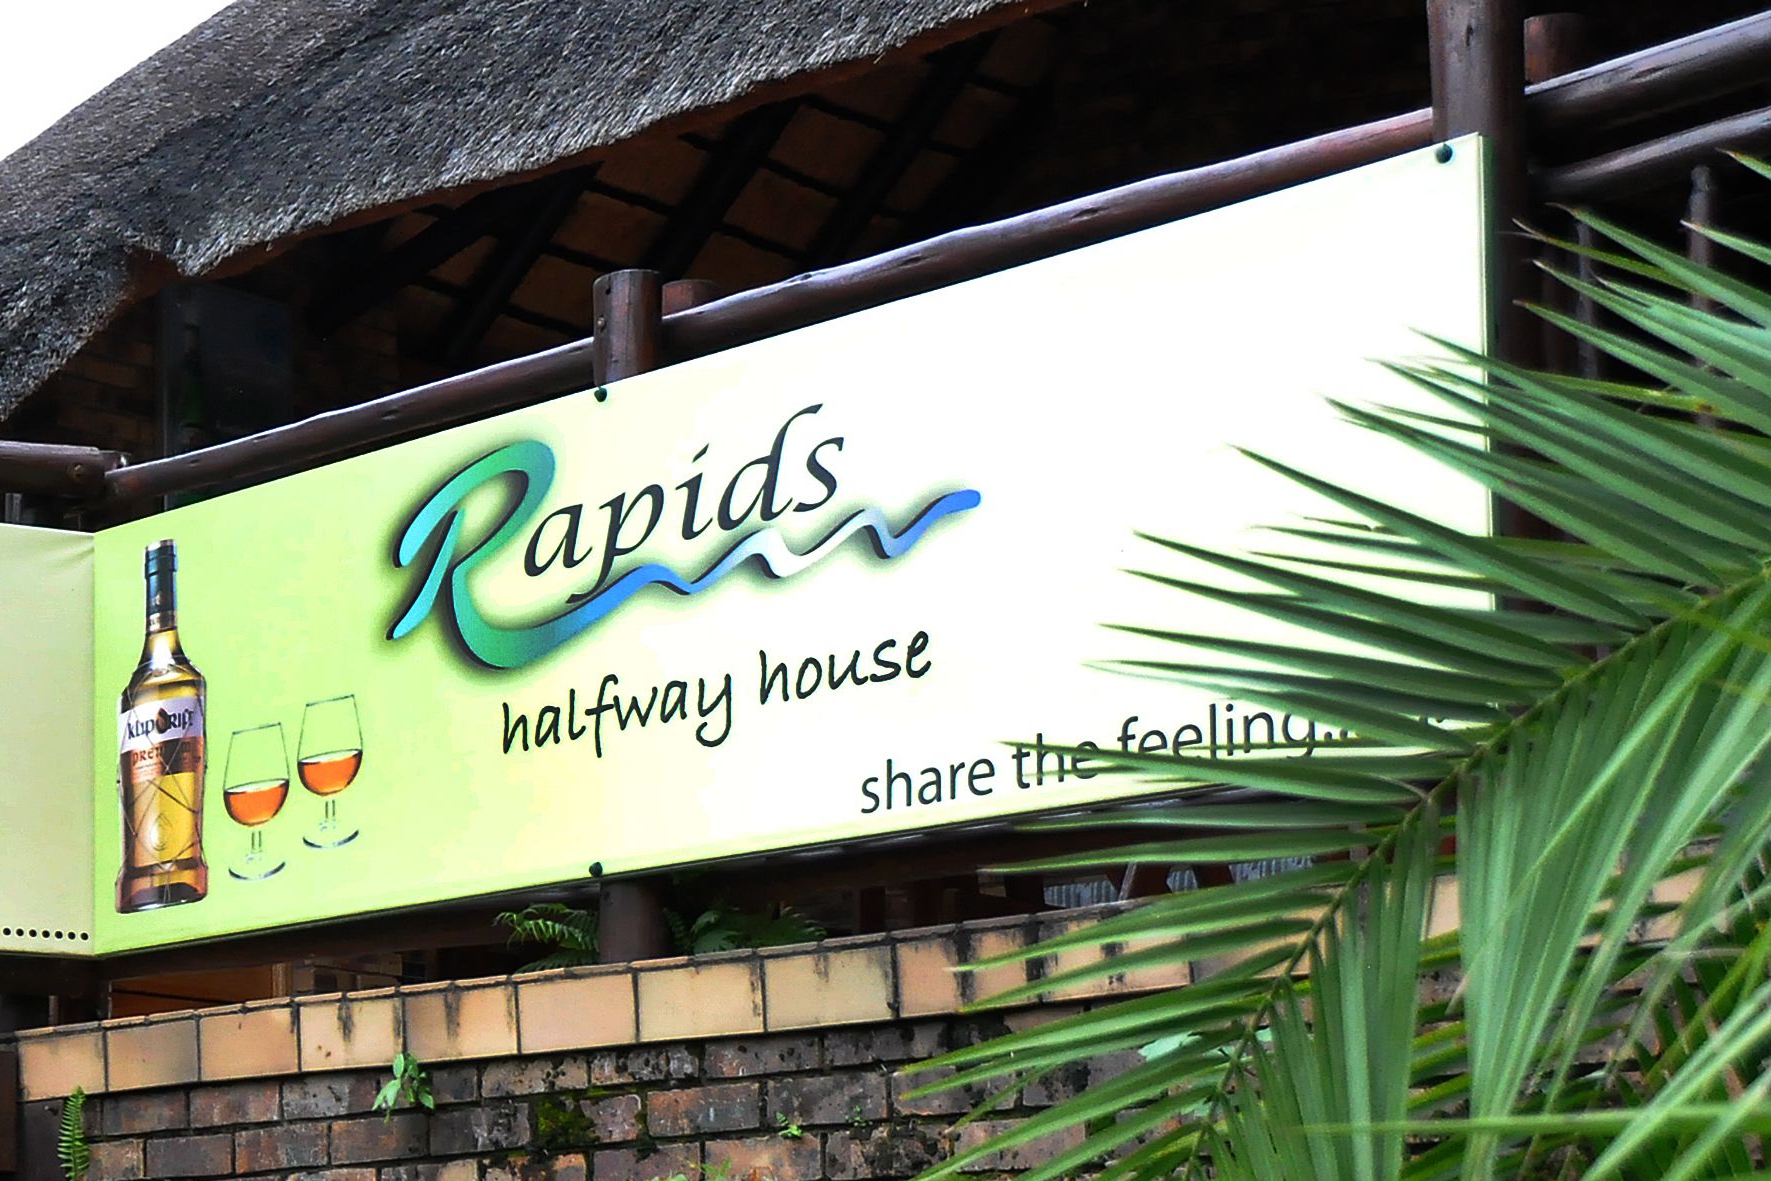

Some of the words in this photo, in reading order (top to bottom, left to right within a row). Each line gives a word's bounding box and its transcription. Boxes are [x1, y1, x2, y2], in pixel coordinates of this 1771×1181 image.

[386, 403, 845, 670] Rapids
[502, 673, 732, 758] halfway
[760, 630, 932, 706] house
[861, 757, 996, 814] share
[1011, 732, 1099, 789] the
